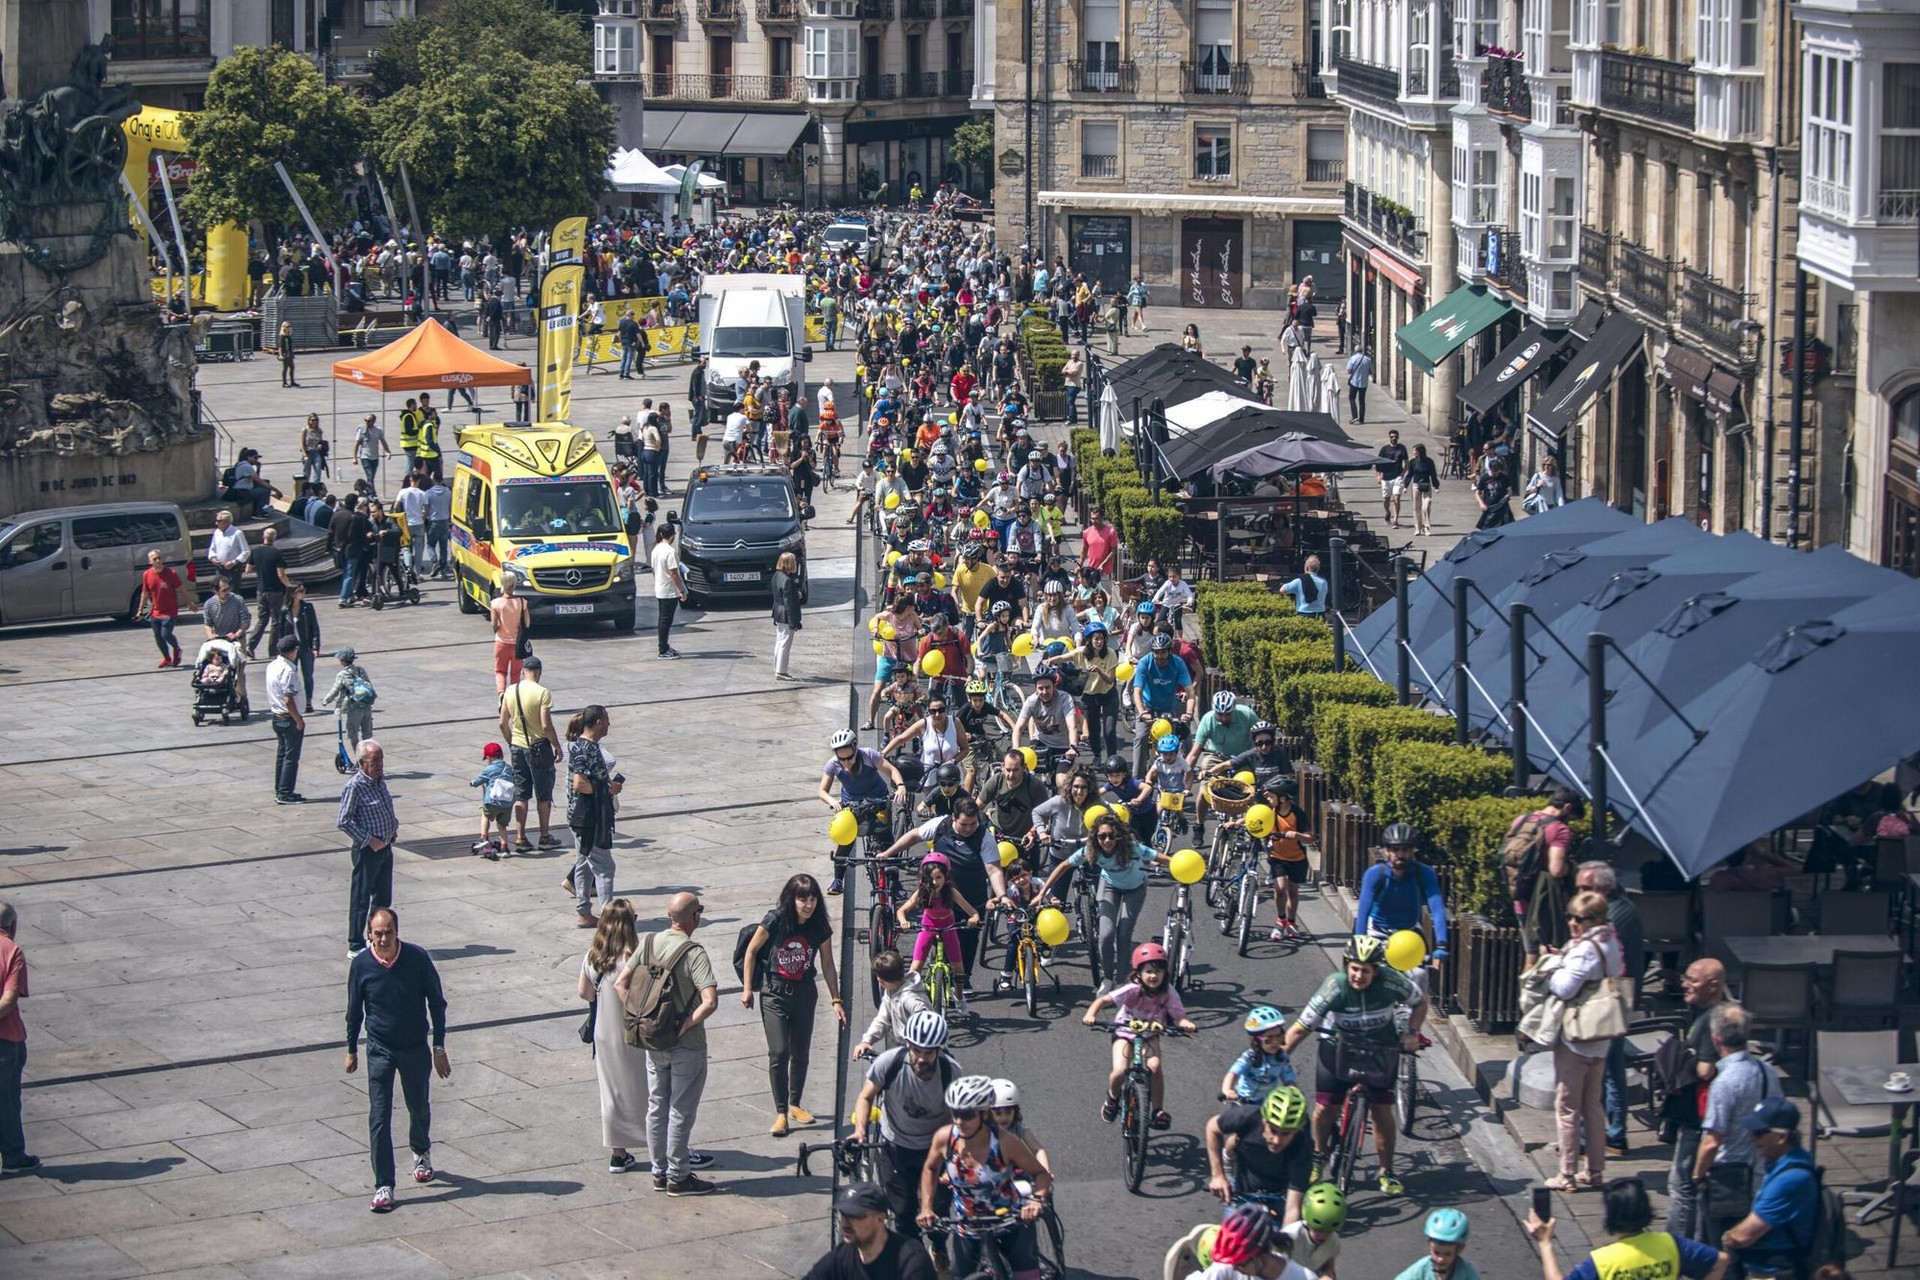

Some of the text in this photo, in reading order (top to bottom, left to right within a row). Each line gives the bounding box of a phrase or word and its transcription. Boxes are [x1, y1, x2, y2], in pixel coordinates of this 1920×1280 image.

[130, 117, 154, 141] Ongi
[547, 306, 562, 317] VIVE
[549, 320, 556, 329] LE
[53, 479, 65, 490] DE
[70, 477, 98, 489] JUNIO
[102, 476, 114, 486] DE
